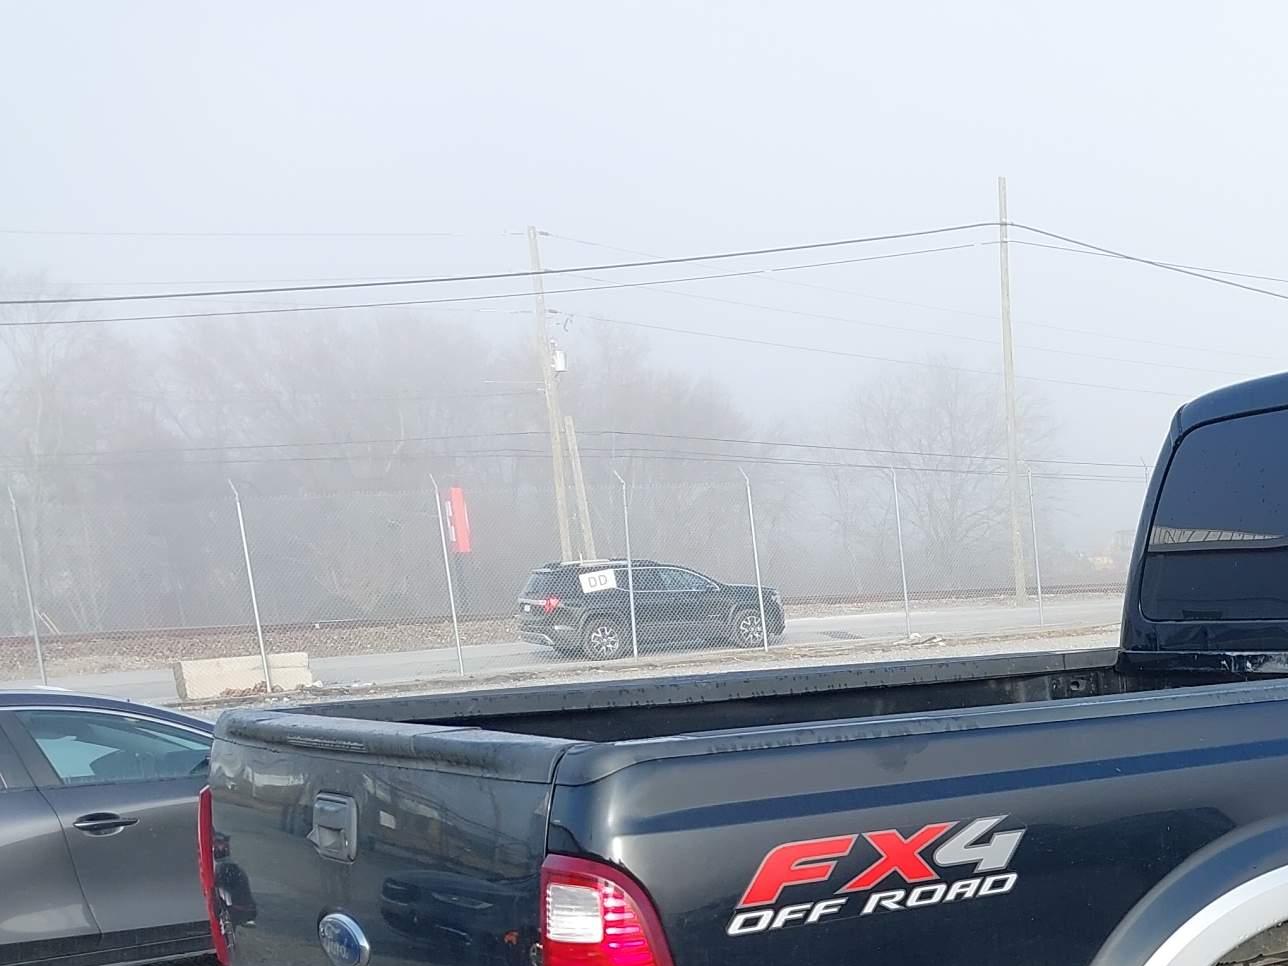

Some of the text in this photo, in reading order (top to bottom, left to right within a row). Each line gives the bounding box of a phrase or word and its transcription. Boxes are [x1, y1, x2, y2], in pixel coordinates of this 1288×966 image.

[735, 815, 1027, 910] FX4
[727, 873, 1018, 936] OFF ROAD
